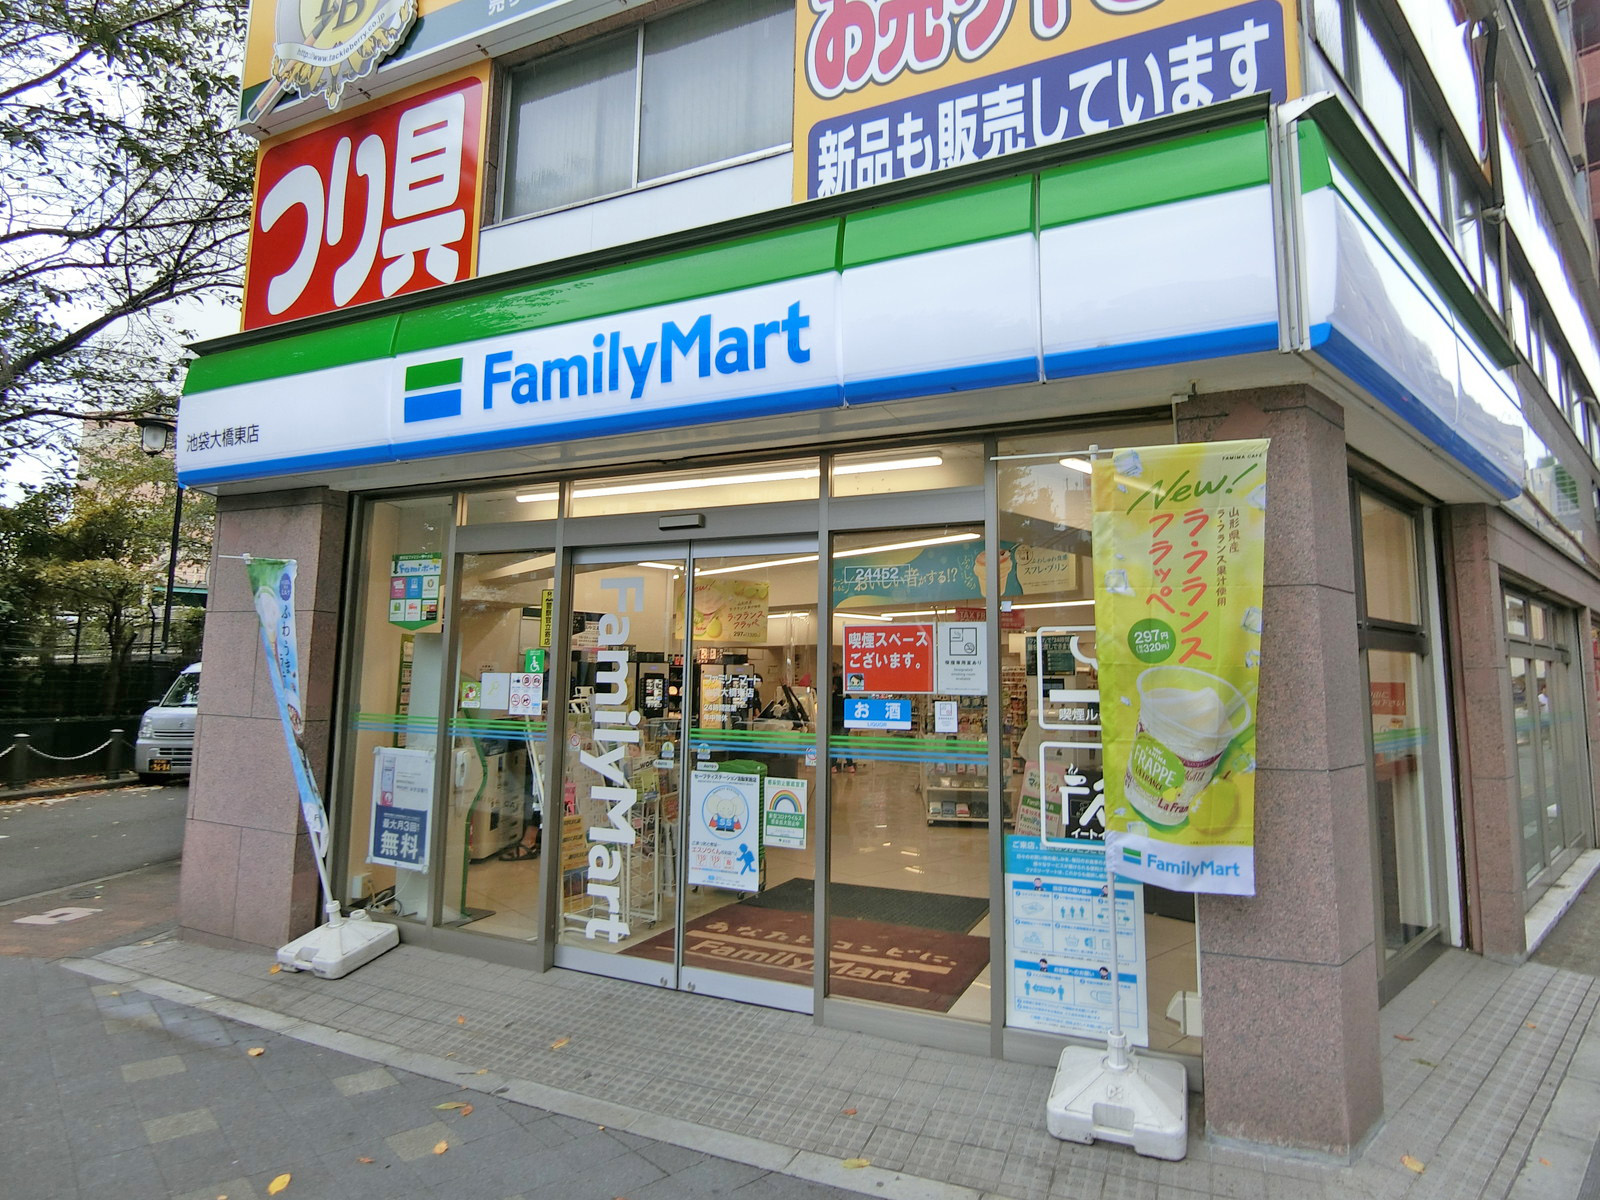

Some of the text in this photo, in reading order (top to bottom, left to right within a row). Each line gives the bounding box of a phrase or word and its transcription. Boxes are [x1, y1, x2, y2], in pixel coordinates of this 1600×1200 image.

[816, 18, 1271, 198] 新品も販売しています
[260, 92, 466, 316] つり具
[482, 300, 811, 410] FamilyMart
[186, 424, 260, 452] 池袋大橋東店
[1126, 462, 1258, 516] New!
[1228, 506, 1240, 554] 山形県産
[855, 567, 899, 581] 24452
[1146, 512, 1176, 615] フラッペ
[1178, 507, 1213, 665] ラ・フランス
[847, 631, 929, 650] 喫煙スペース
[849, 651, 922, 670] ございます。
[580, 576, 645, 943] FamilyMart
[380, 830, 418, 860] 無料
[1146, 853, 1241, 878] FamilyMart
